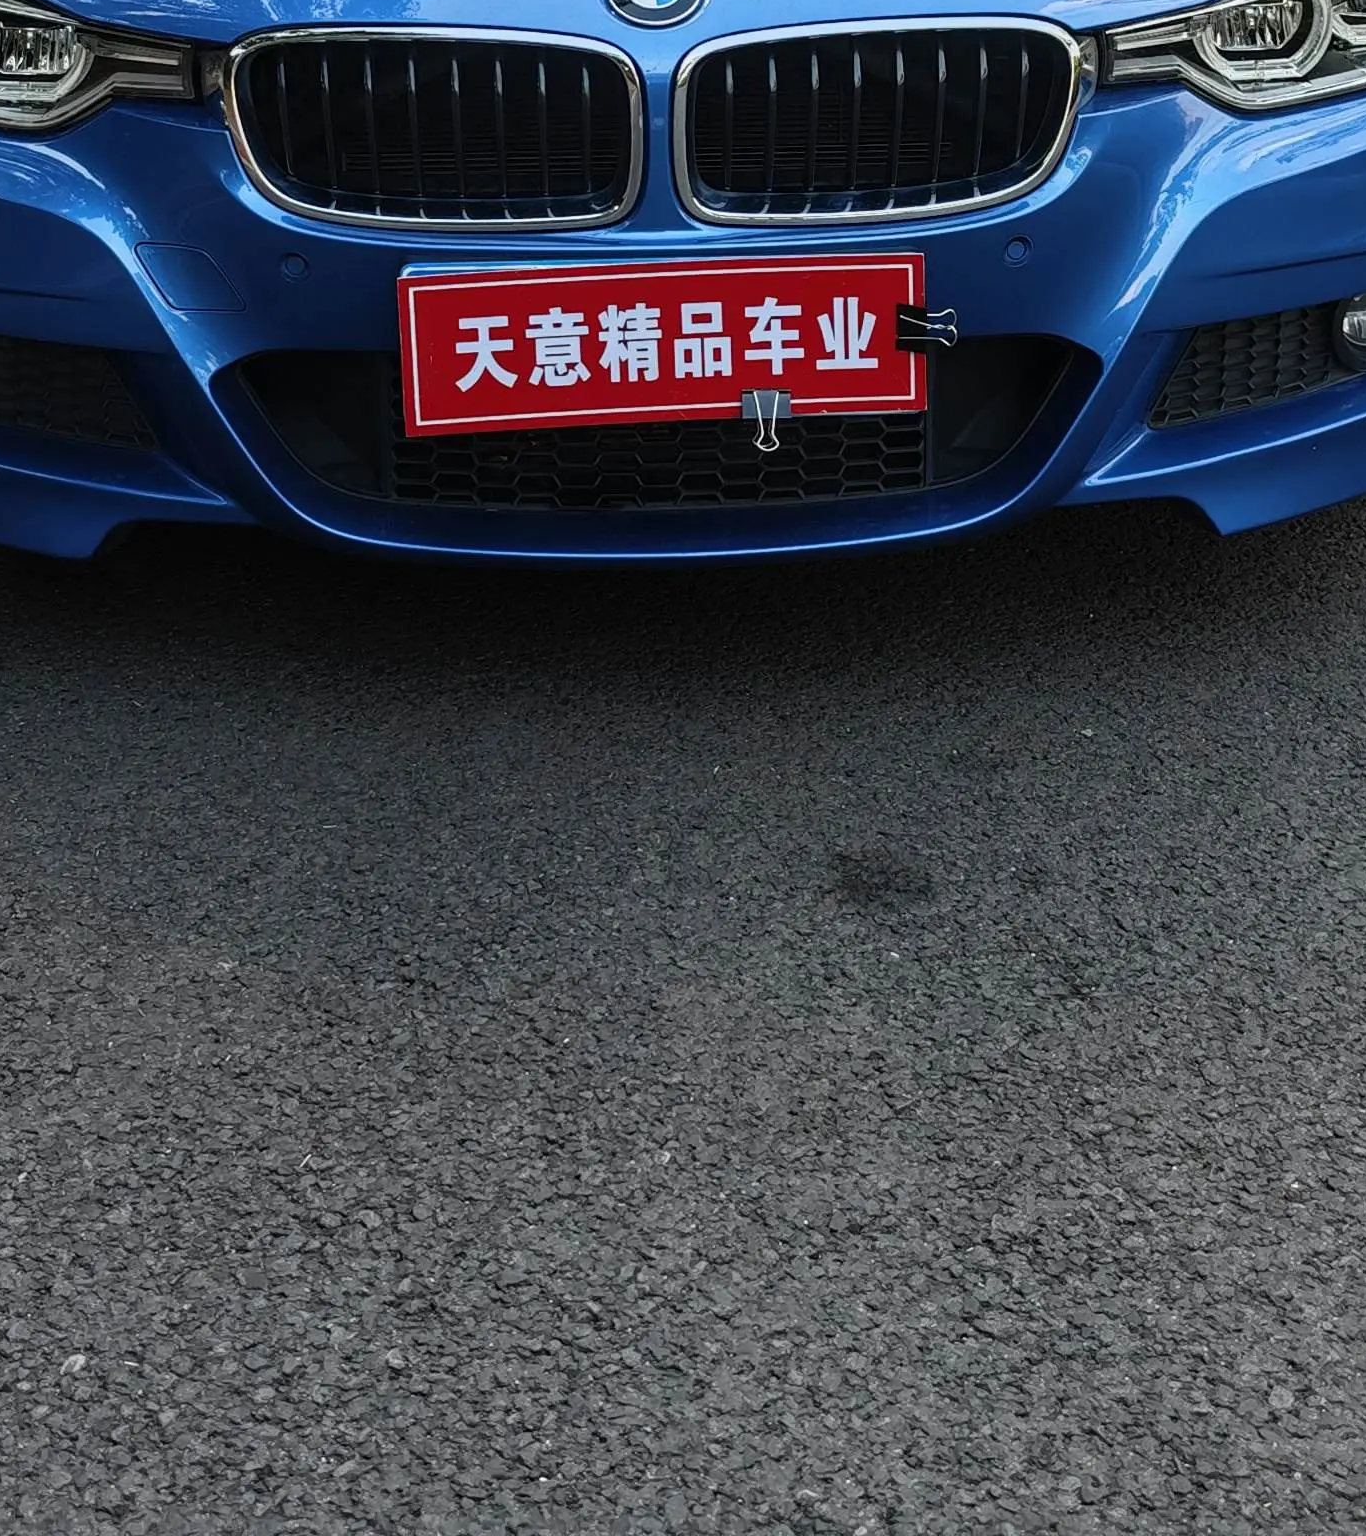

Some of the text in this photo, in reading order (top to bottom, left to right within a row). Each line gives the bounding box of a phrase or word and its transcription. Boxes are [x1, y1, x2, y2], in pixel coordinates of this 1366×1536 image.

[454, 296, 879, 393] 天意精品车业
